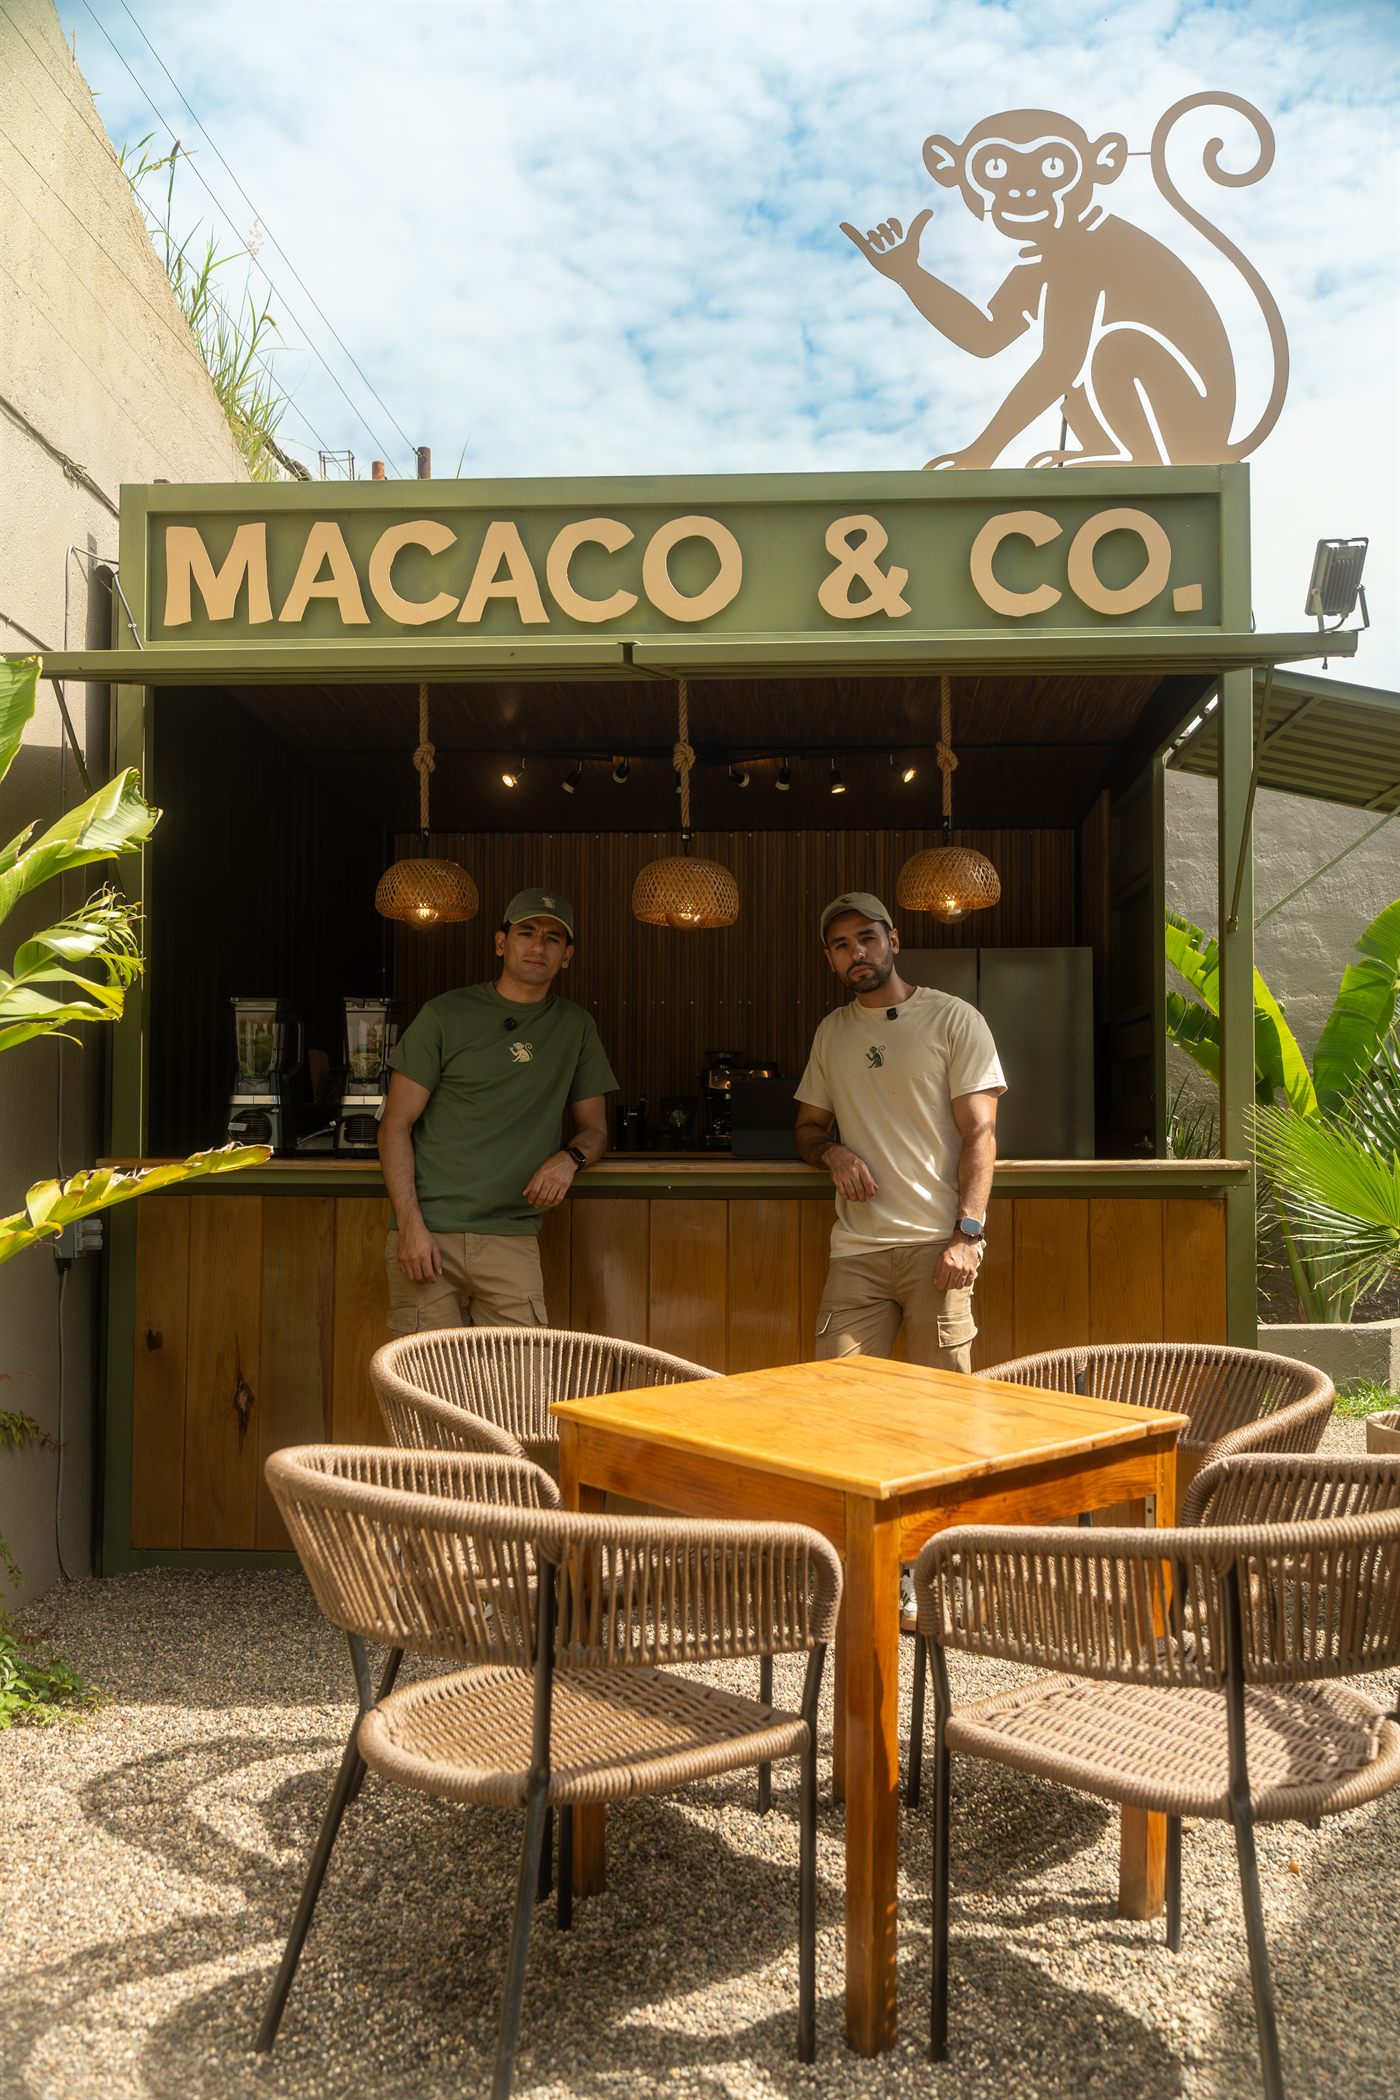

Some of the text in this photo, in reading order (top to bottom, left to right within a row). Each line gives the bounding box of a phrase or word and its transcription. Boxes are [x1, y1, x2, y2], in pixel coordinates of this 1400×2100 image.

[163, 507, 1203, 626] MACACO & CO.
